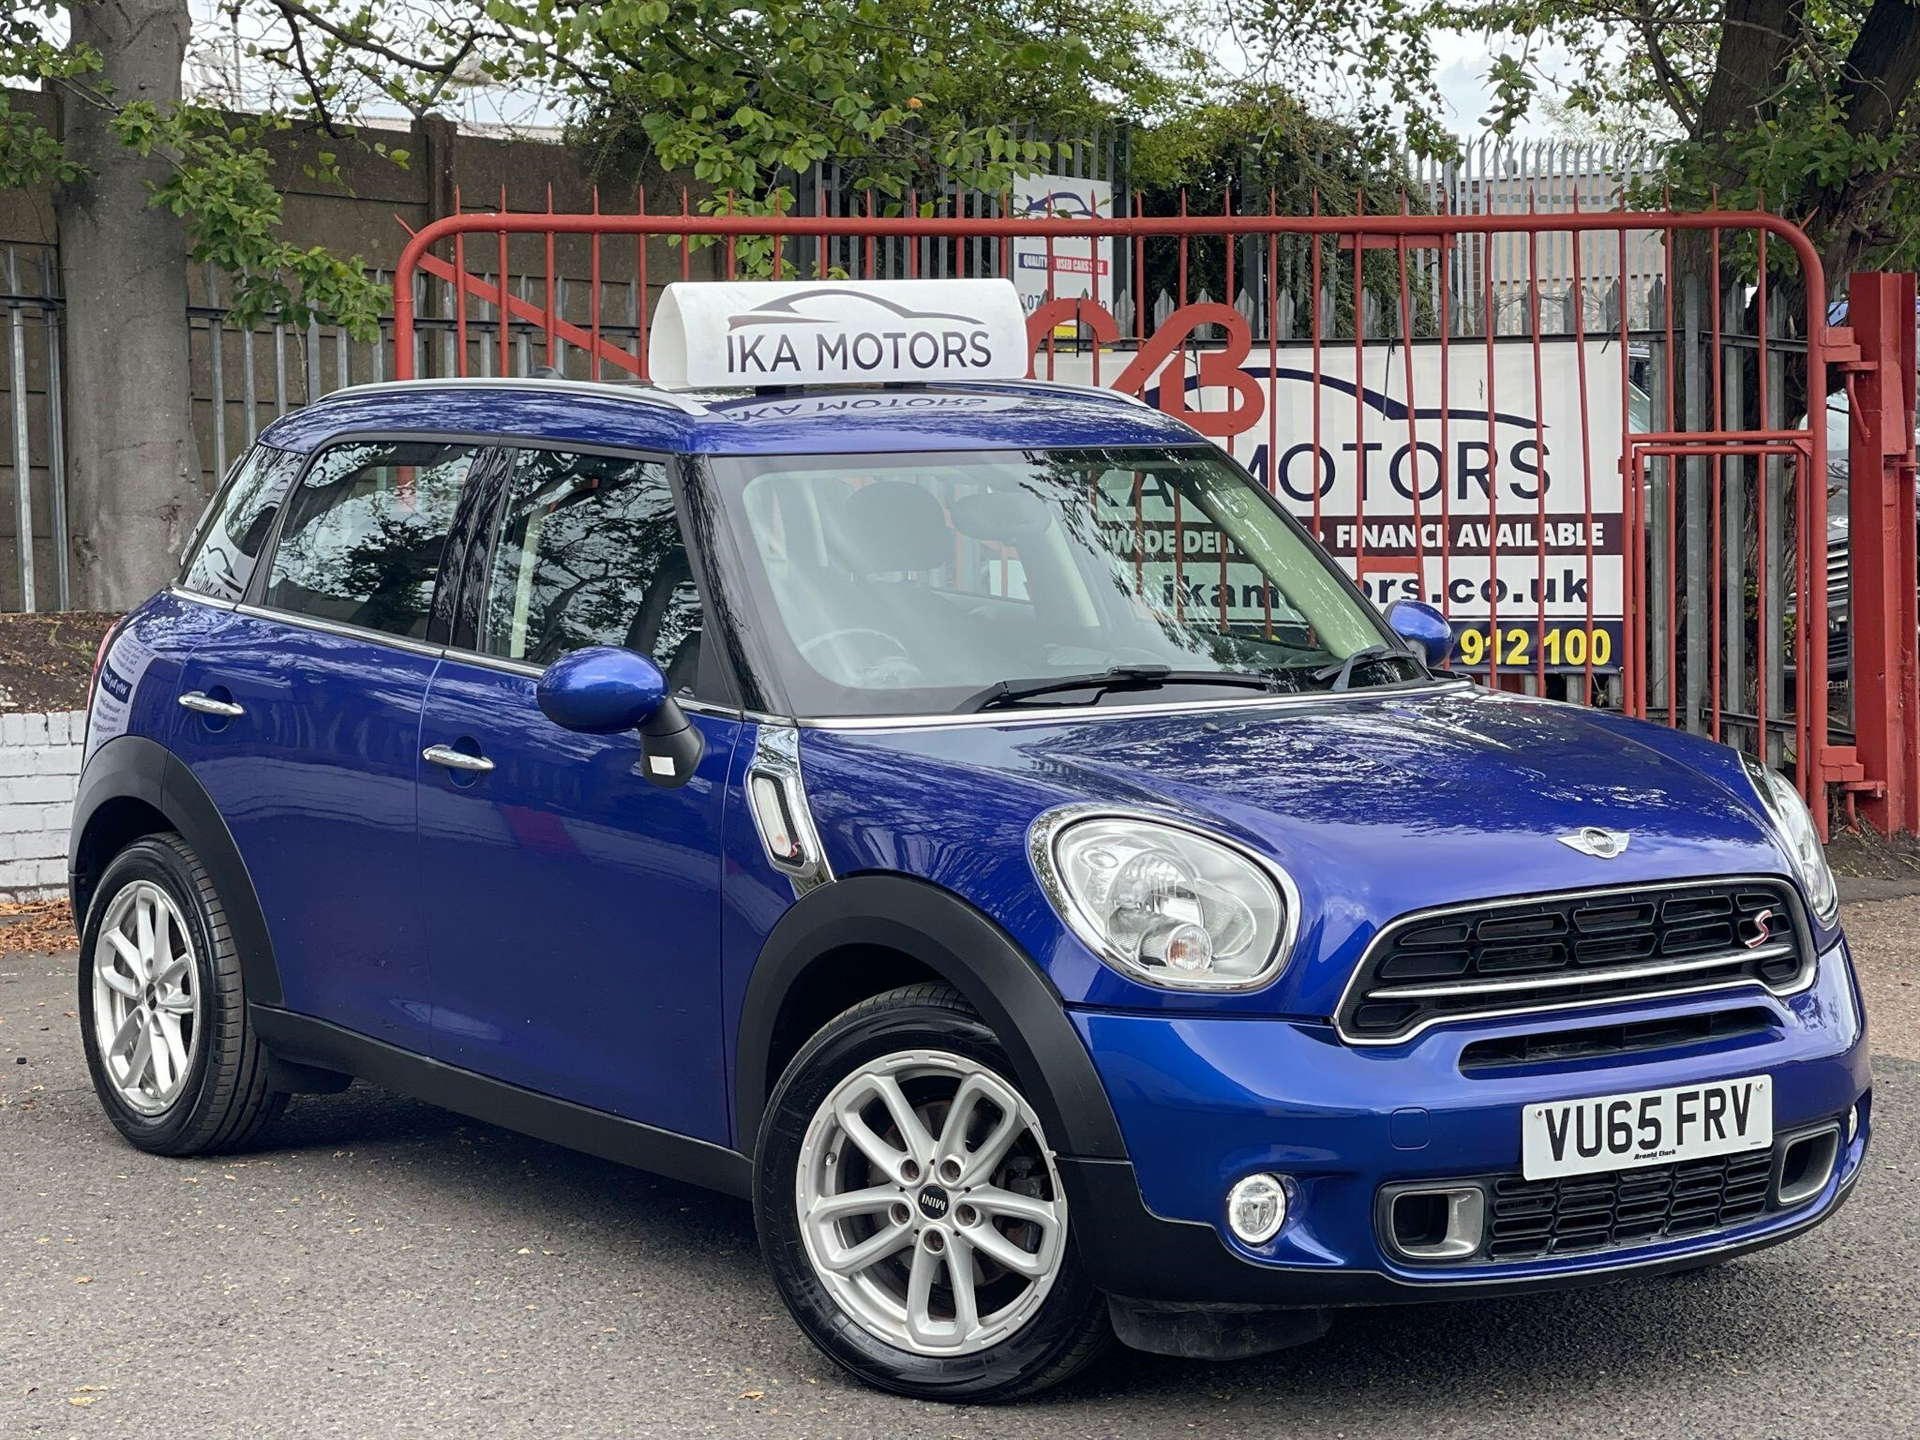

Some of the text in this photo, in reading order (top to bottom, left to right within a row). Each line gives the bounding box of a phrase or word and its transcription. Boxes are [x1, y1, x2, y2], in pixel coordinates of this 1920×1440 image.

[1056, 257, 1072, 270] USED
[727, 331, 992, 373] IKA MOTORS
[1457, 522, 1604, 548] AVAILABLE
[1461, 628, 1611, 665] 912 100
[1545, 1083, 1752, 1161] VU65 FRV
[1634, 1149, 1676, 1160] Arnold Clark
[922, 1194, 946, 1210] MINI
